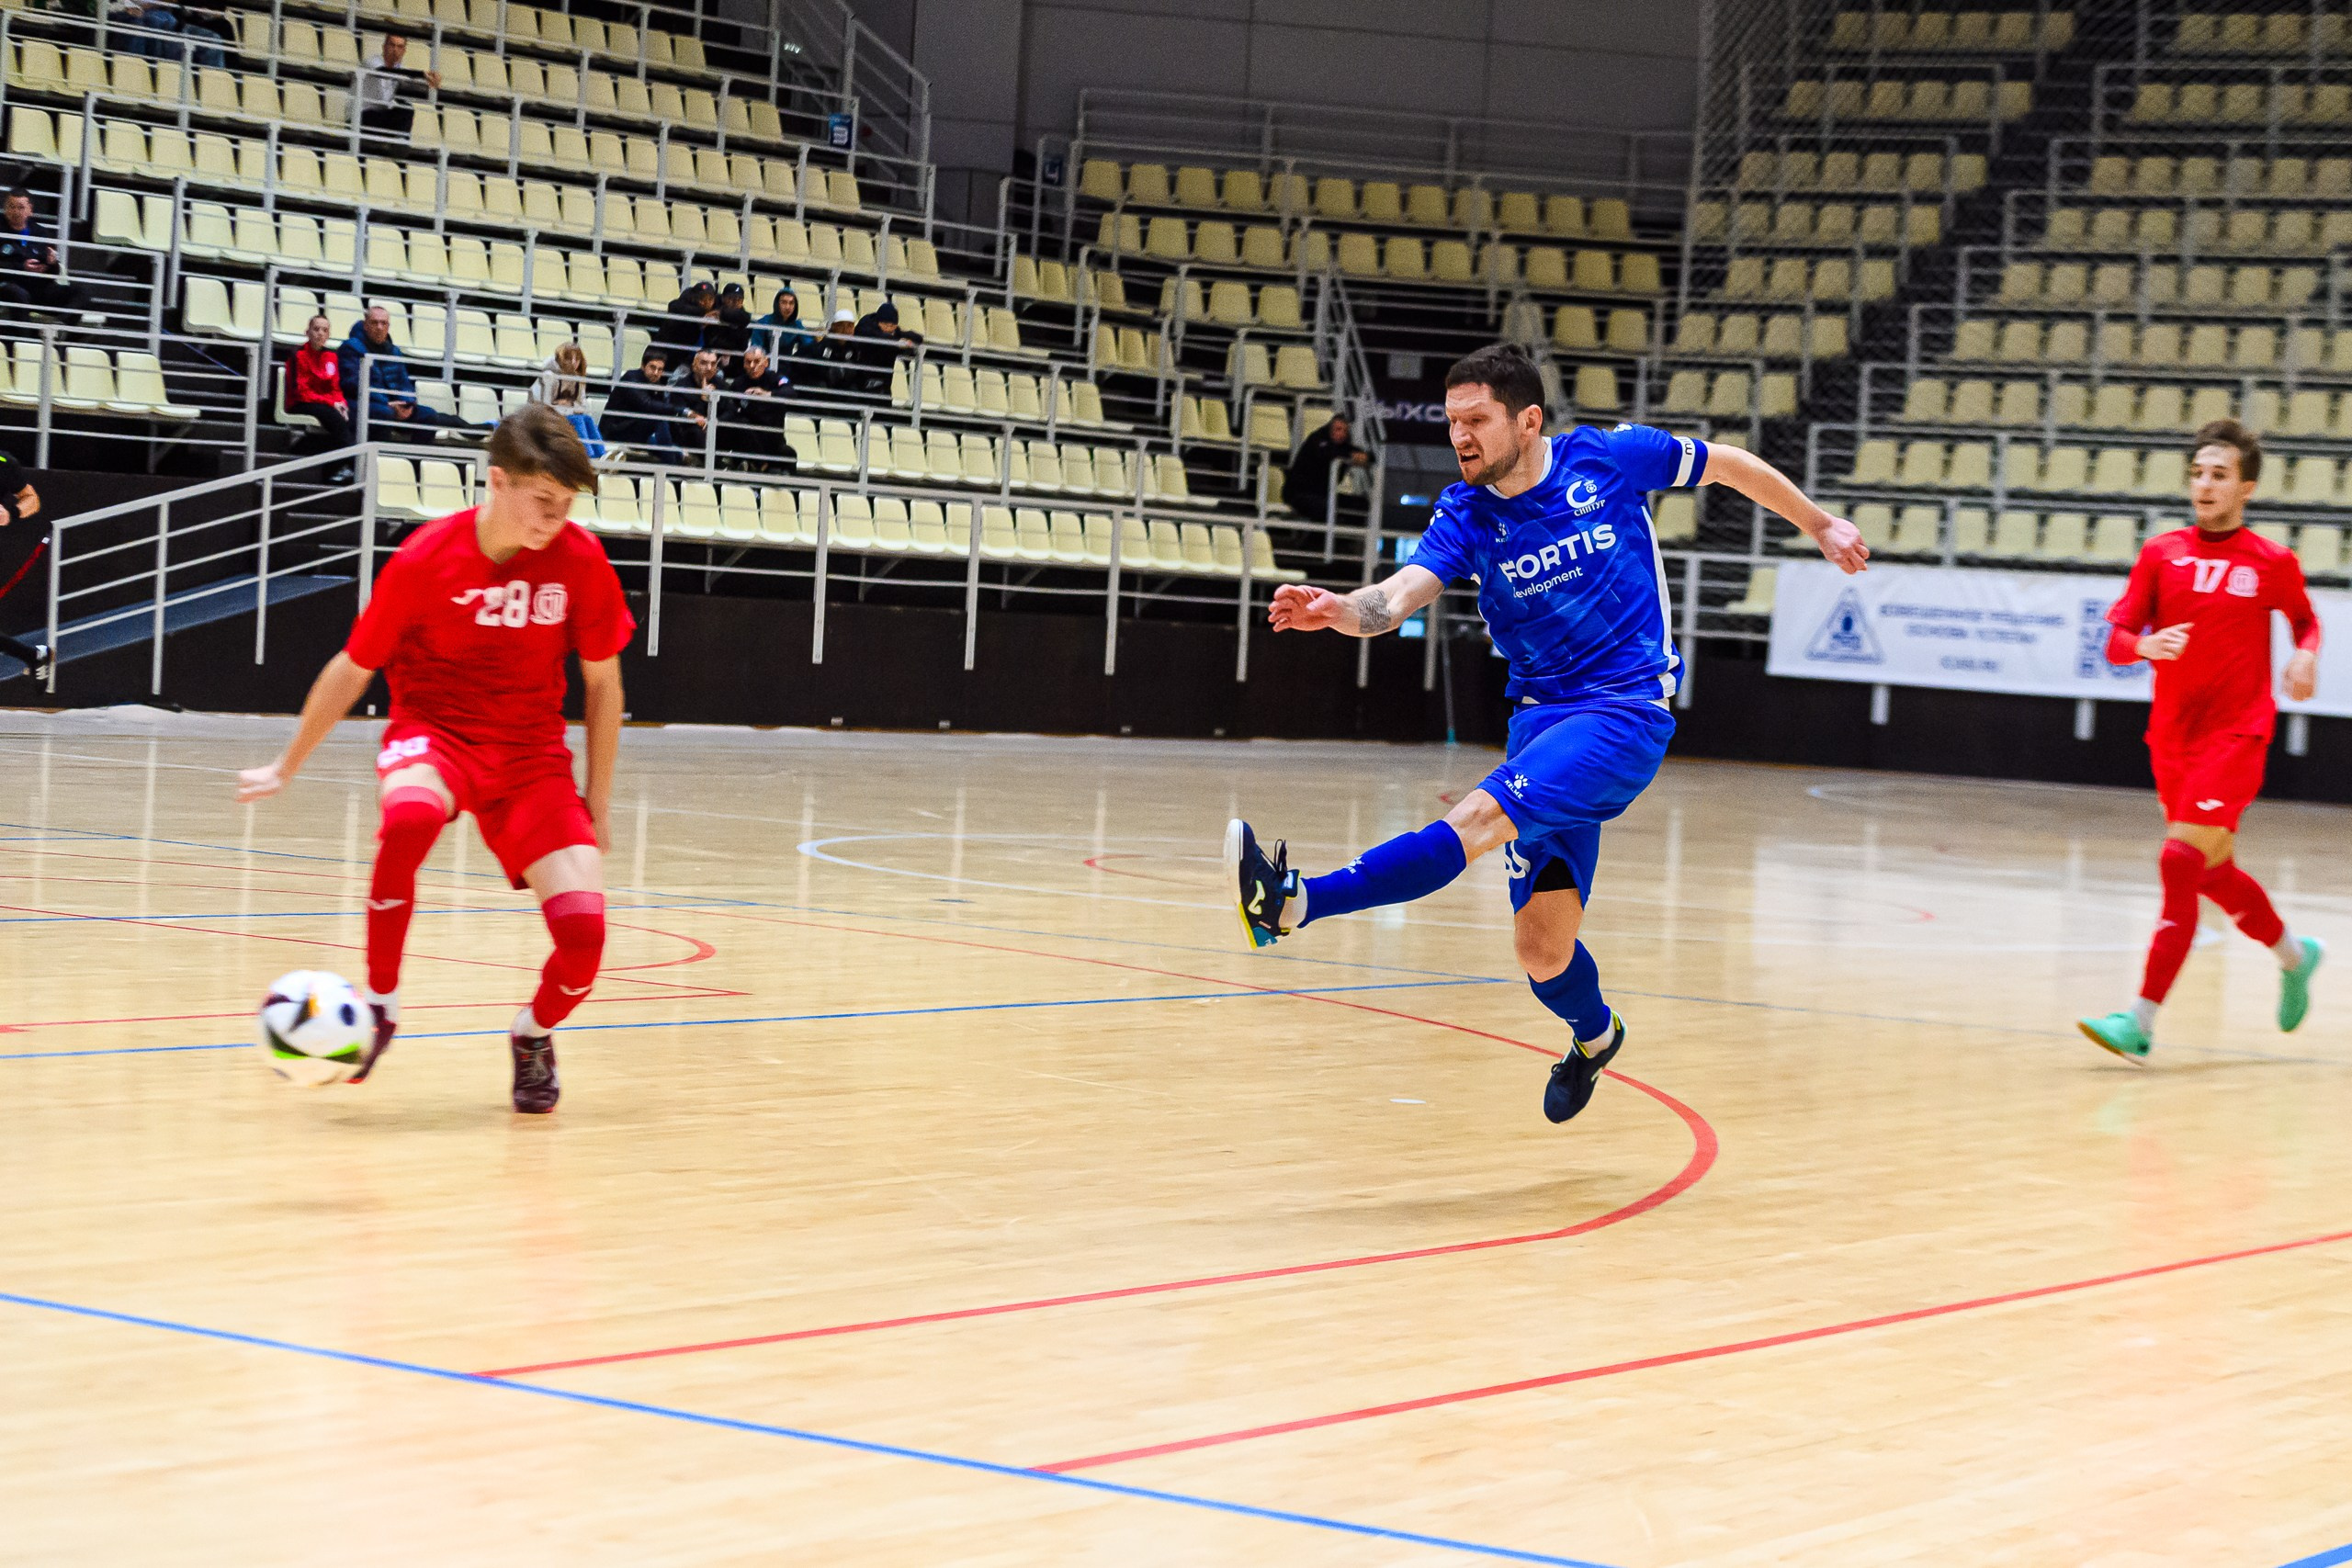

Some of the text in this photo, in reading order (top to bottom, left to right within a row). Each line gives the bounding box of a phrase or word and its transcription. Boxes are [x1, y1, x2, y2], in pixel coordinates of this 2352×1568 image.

[1498, 524, 1616, 583] FORTIS
[2192, 558, 2232, 593] 17
[474, 580, 531, 628] 28
[1504, 779, 1524, 800] KELME
